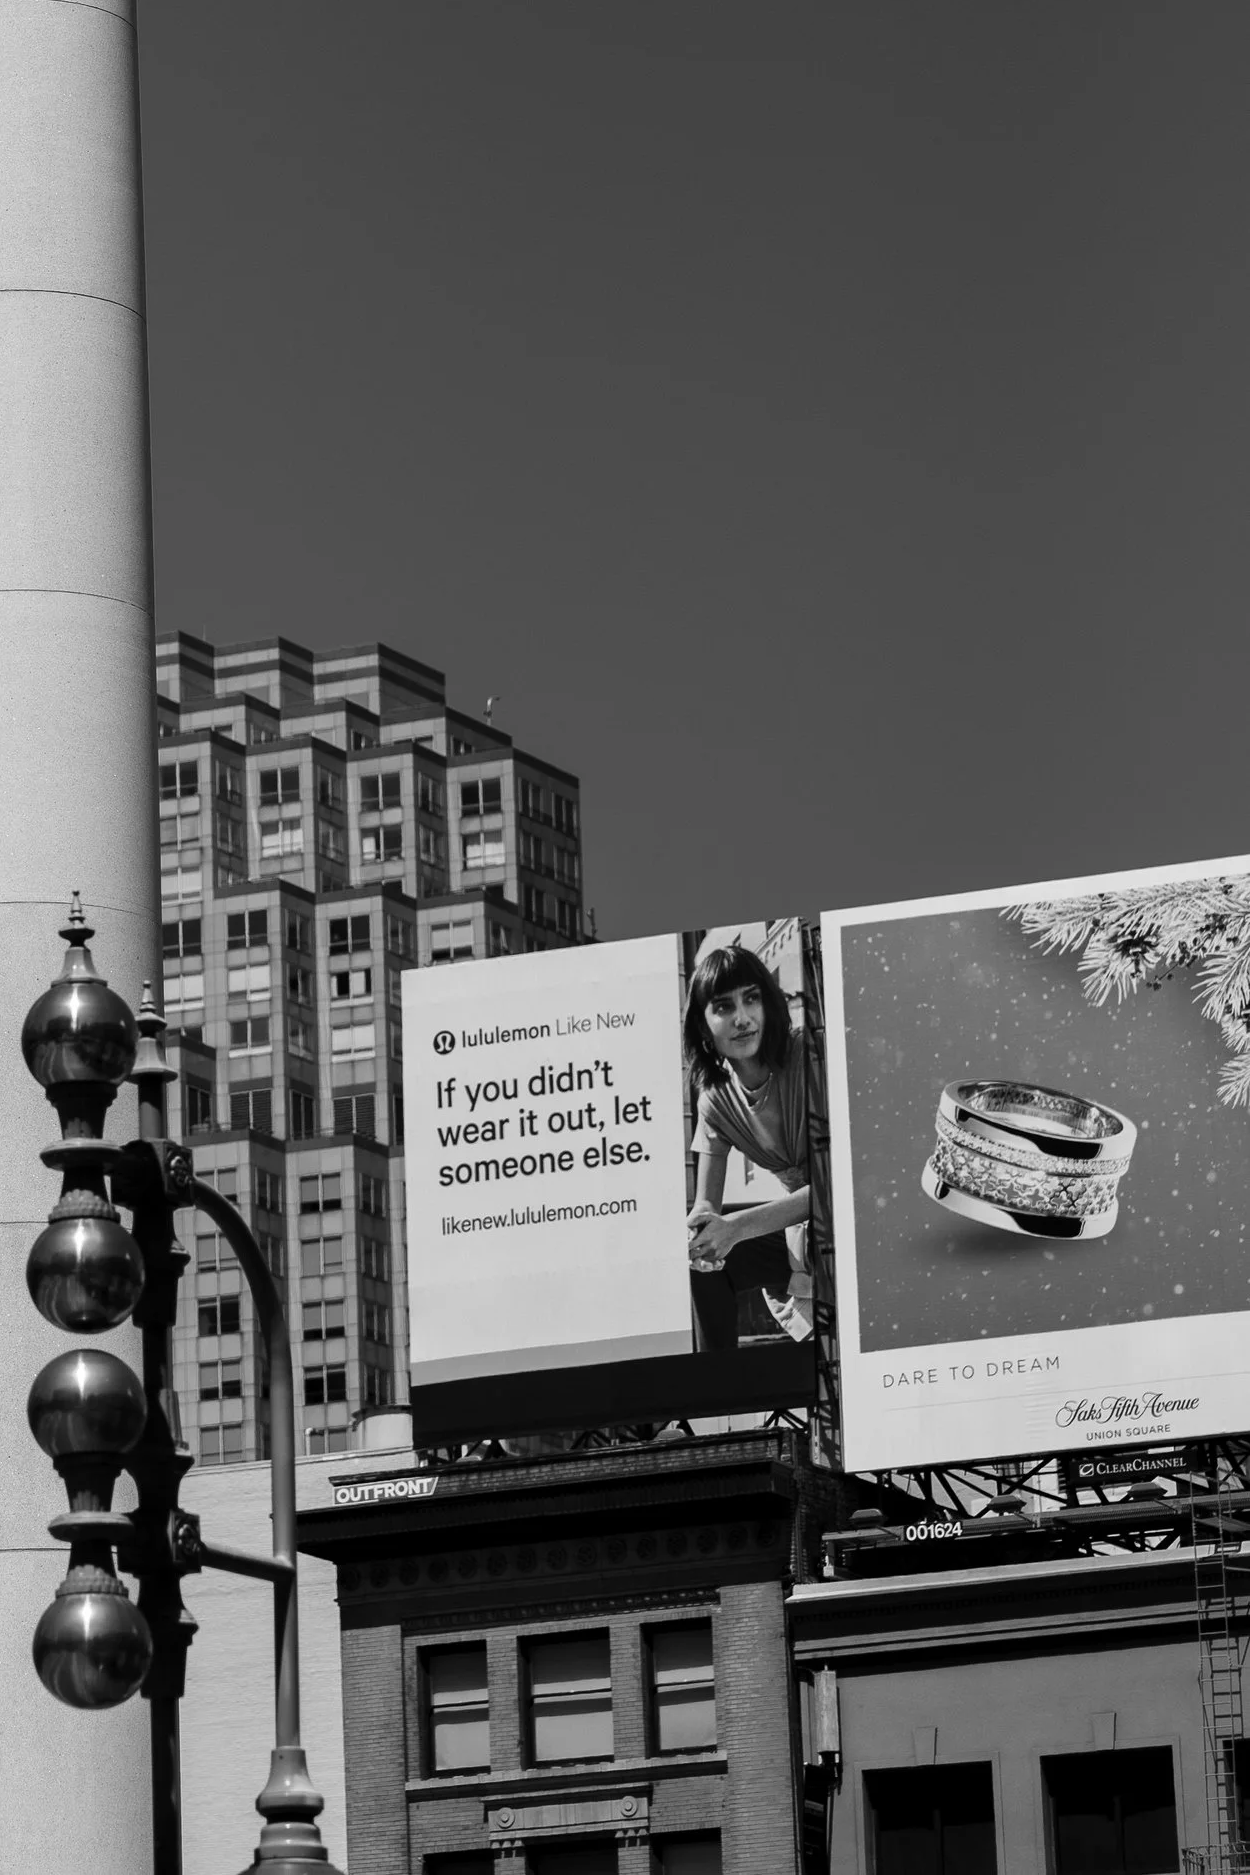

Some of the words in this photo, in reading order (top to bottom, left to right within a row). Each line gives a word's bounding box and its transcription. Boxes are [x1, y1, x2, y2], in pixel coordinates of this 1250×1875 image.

[462, 1024, 550, 1048] lululemon
[556, 1015, 591, 1036] Like
[597, 1012, 635, 1030] New
[437, 1077, 456, 1109] If
[465, 1078, 518, 1112] you
[528, 1060, 614, 1096] didn’t
[437, 1117, 510, 1147] wear
[519, 1108, 539, 1137] it
[548, 1102, 605, 1133] out,
[614, 1095, 652, 1126] let
[439, 1150, 574, 1187] someone
[582, 1137, 651, 1169] else.
[442, 1198, 638, 1236] likenew.lululemon.com
[882, 1368, 938, 1388] DARE
[949, 1364, 975, 1381] TO
[986, 1356, 1060, 1378] DREAM
[1055, 1399, 1102, 1428] Saks
[1096, 1396, 1140, 1424] Fifth
[1130, 1391, 1200, 1420] Avenue
[1085, 1429, 1122, 1441] UNION
[1125, 1423, 1171, 1437] SQUARE
[336, 1478, 433, 1503] OUTFRONT
[906, 1522, 963, 1541] 001624
